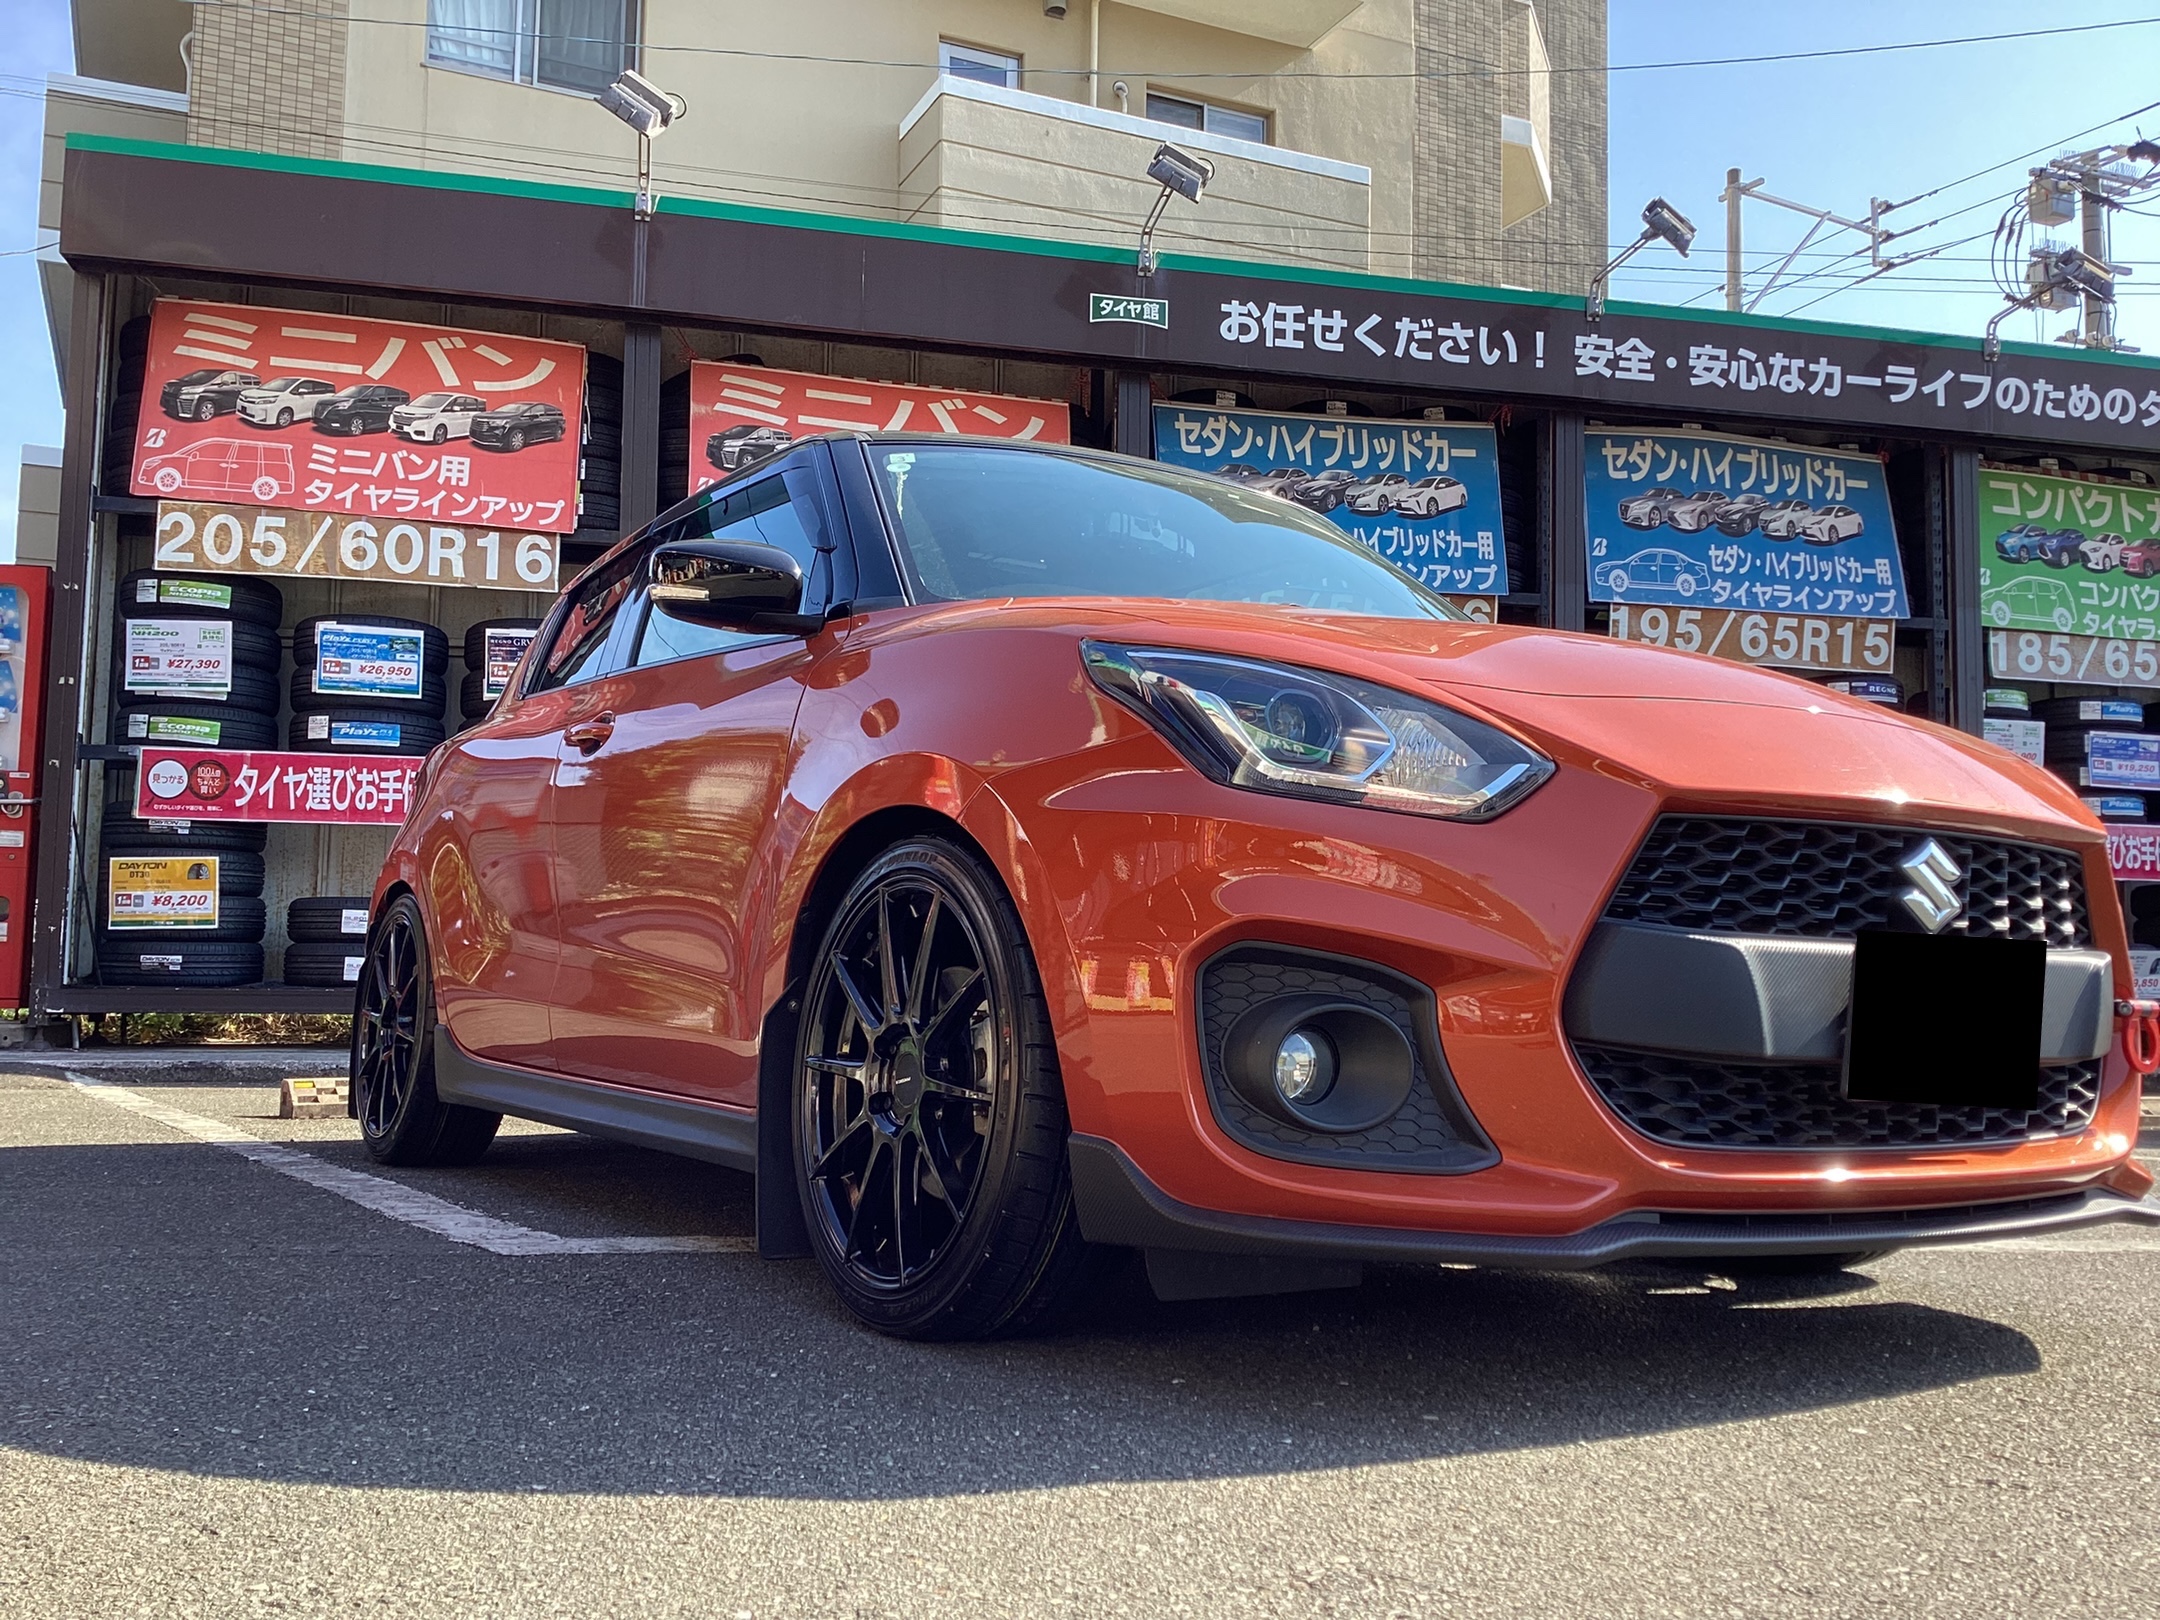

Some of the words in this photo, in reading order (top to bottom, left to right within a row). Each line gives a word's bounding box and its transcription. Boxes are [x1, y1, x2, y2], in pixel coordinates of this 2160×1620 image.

[1098, 298, 1161, 322] タイヤ館
[173, 312, 558, 392] ミニバン
[713, 373, 1045, 440] ミニバン
[1174, 412, 1477, 473] セダン・ハイブリッドカー
[306, 443, 471, 488] ミニバン用
[1601, 439, 1869, 502] セダン・ハイブリッドカー
[304, 479, 565, 526] タイヤラインアップ
[157, 511, 553, 584] 205/60R16
[1708, 544, 1893, 586] セダン・ハイブリッドカー用
[1710, 578, 1897, 614] タイヤラインアップ
[1610, 605, 1890, 666] 195/65R15
[2082, 611, 2160, 640] タイヤラ
[166, 658, 221, 671] ¥27,390
[358, 664, 412, 677] ¥26,950
[1990, 632, 2158, 682] 185/65
[151, 773, 185, 784] 見つかる
[2117, 763, 2156, 773] ¥19,250
[118, 862, 168, 870] DAYTON
[151, 895, 208, 908] ¥8,200
